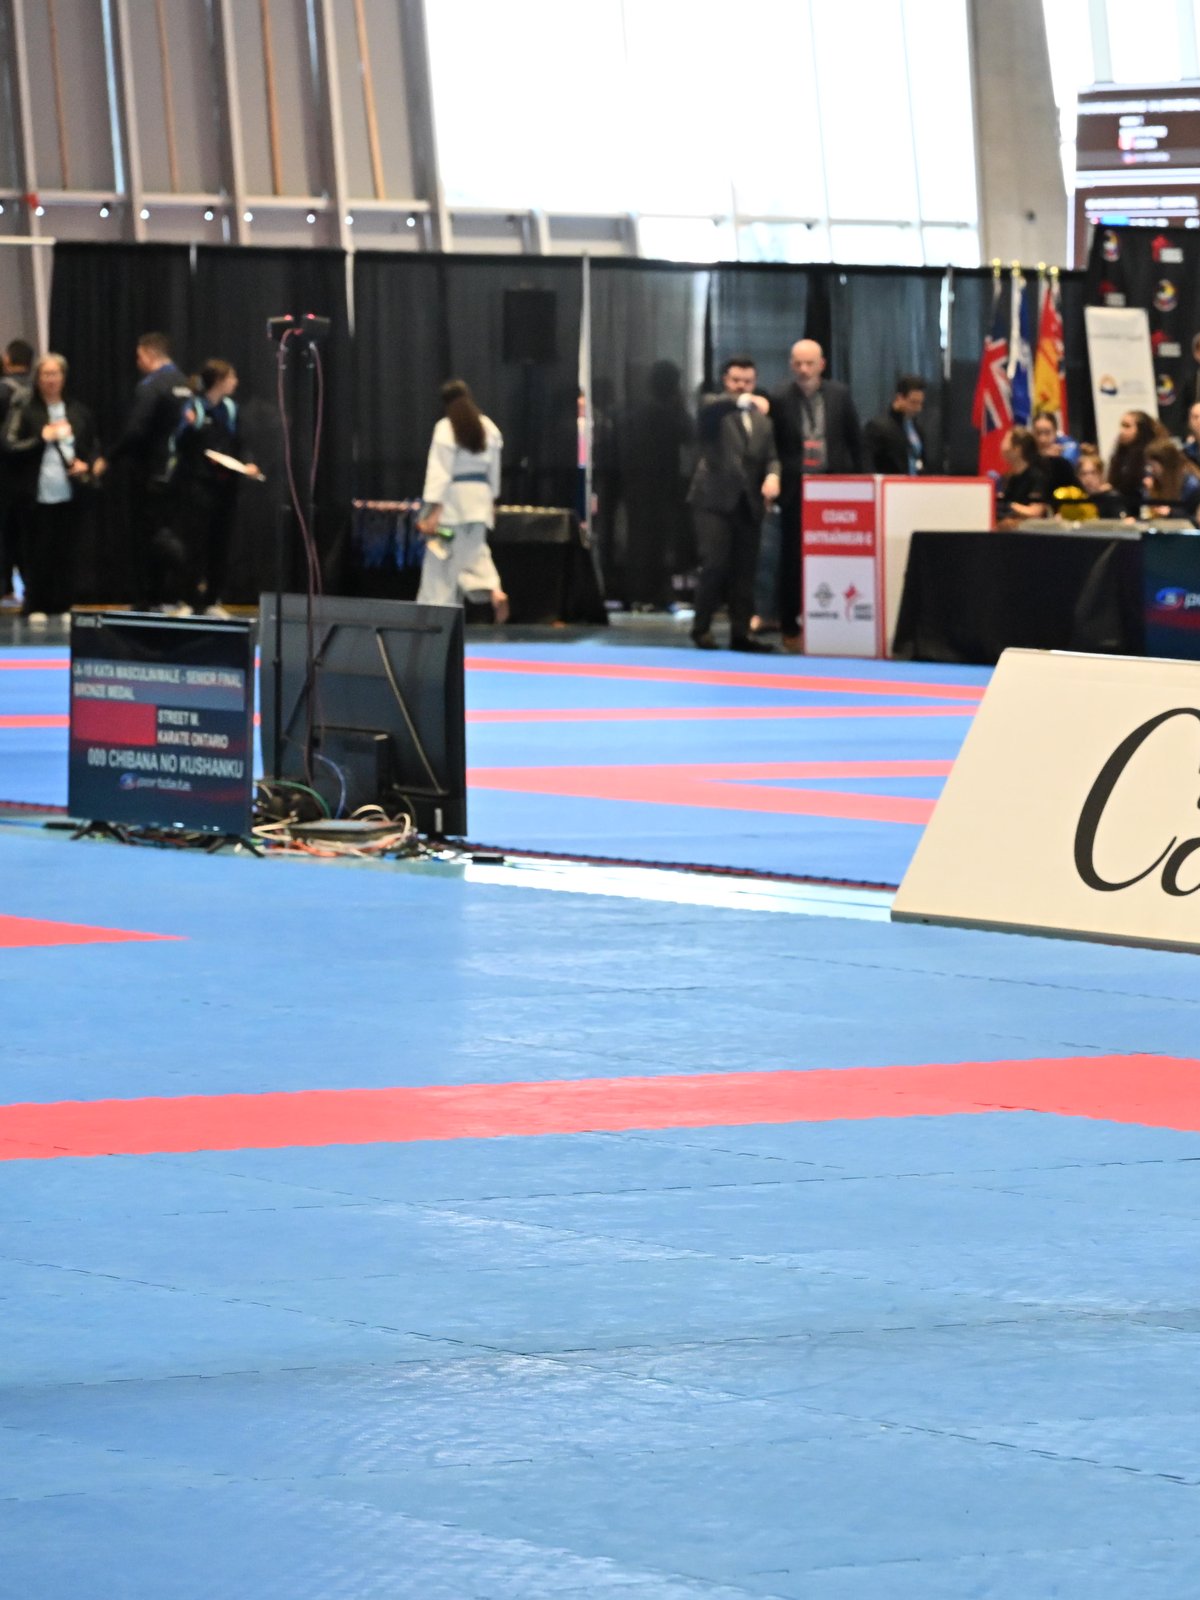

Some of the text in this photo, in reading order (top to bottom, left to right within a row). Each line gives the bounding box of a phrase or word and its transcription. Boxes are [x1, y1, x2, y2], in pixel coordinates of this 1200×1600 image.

[158, 709, 189, 725] STREET
[157, 730, 229, 749] KARATE ONTARIO
[108, 750, 158, 771] CHIBANA
[160, 754, 177, 772] NO
[180, 755, 243, 778] KUSHANKU
